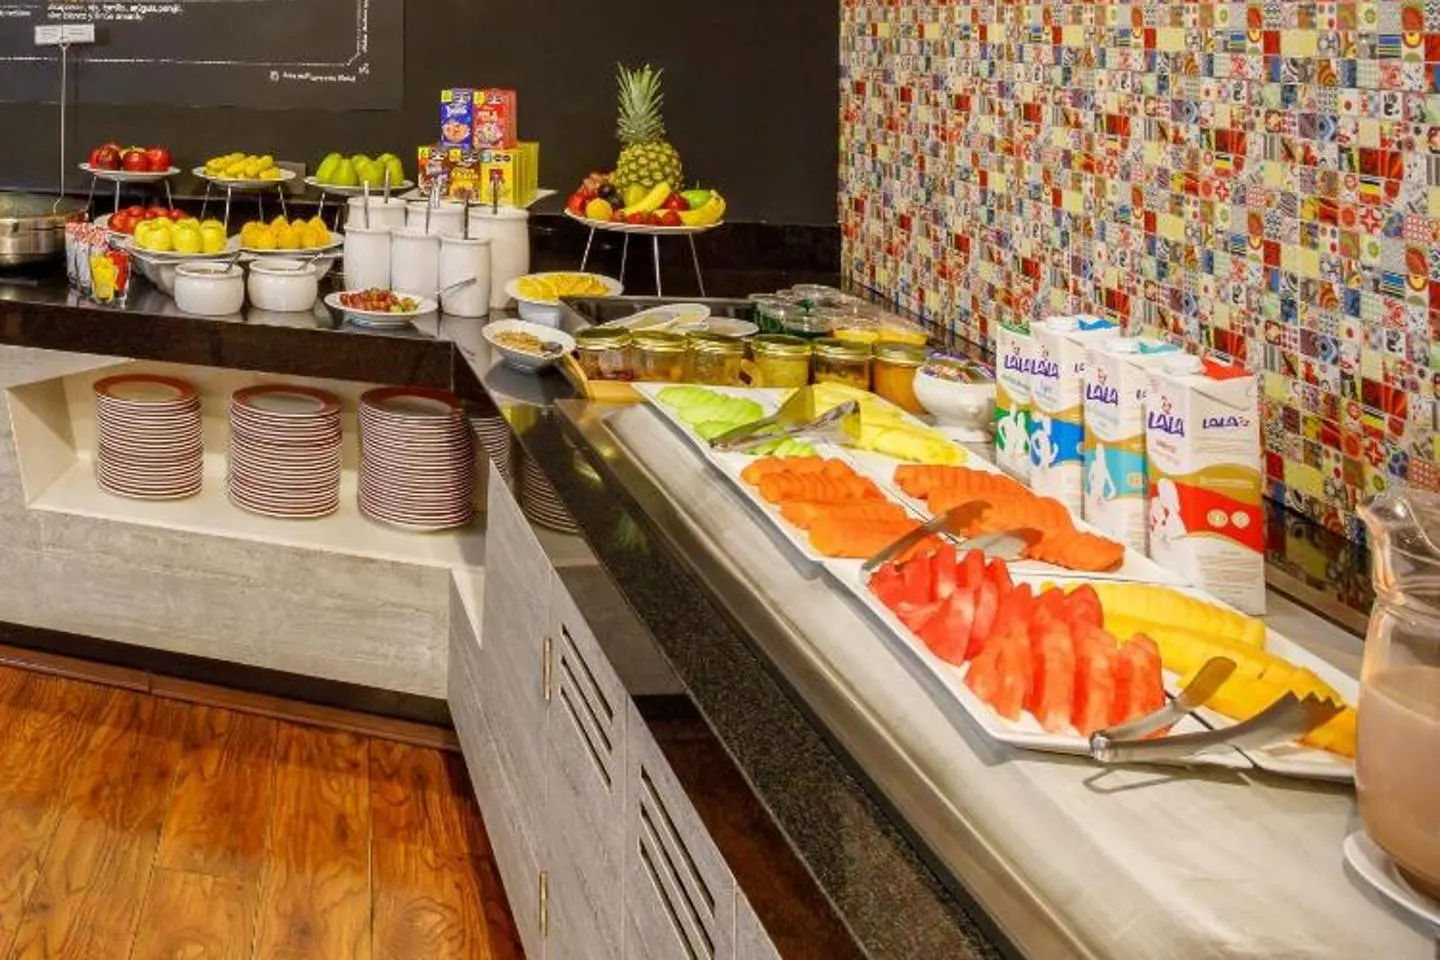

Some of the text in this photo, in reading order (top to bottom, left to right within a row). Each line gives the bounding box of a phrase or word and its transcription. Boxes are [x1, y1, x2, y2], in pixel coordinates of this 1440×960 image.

[1031, 357, 1059, 379] LALA
[1086, 383, 1119, 406] LALA
[1148, 411, 1185, 438] LALA
[1202, 416, 1239, 429] LALA
